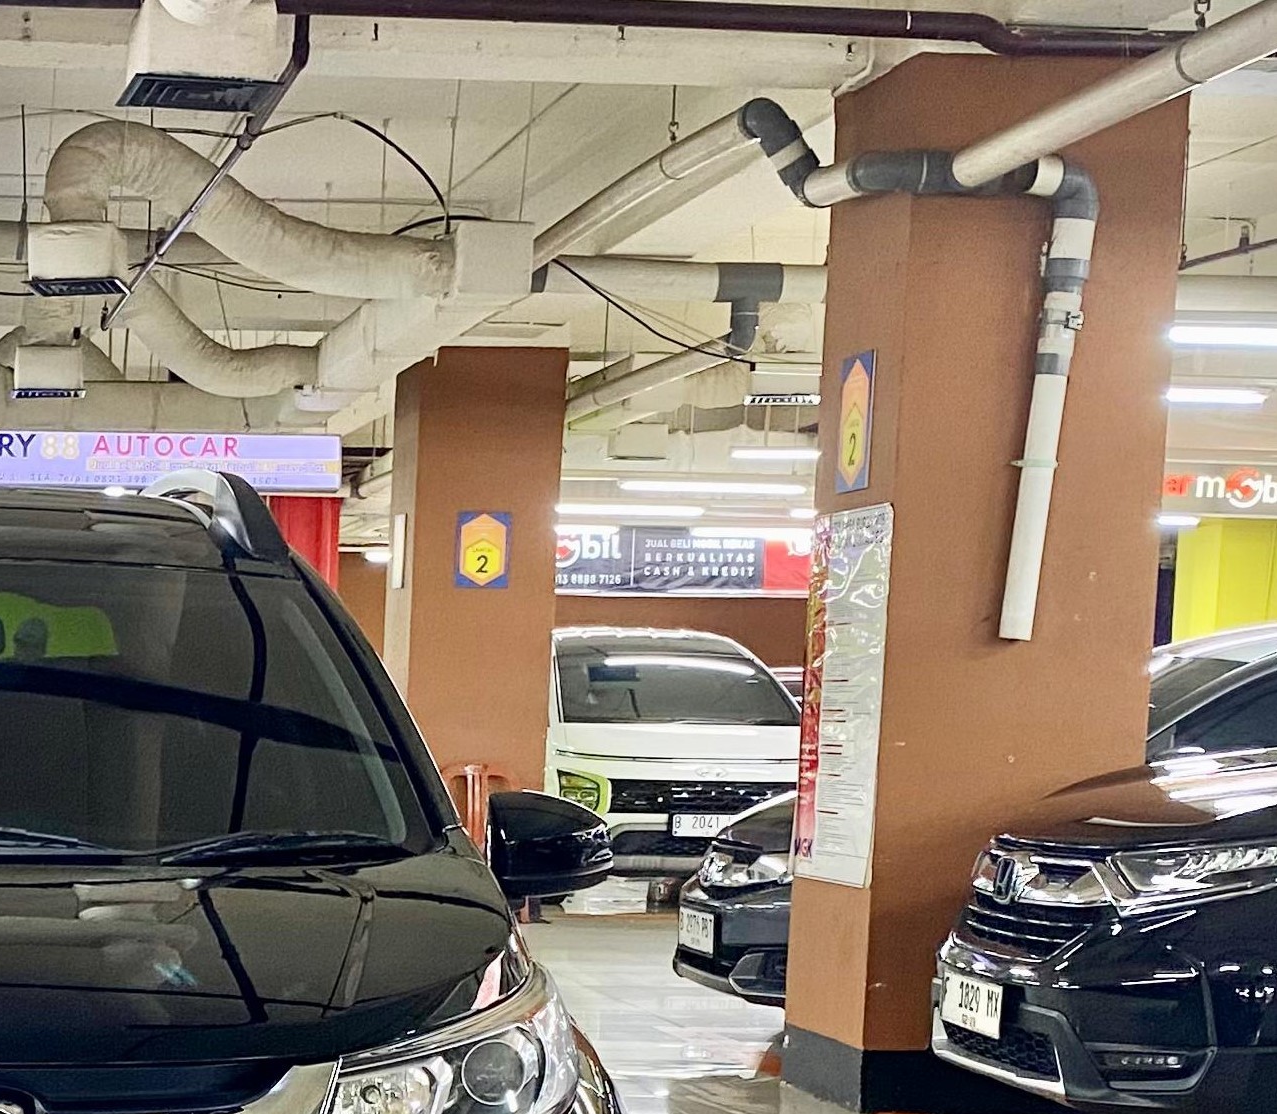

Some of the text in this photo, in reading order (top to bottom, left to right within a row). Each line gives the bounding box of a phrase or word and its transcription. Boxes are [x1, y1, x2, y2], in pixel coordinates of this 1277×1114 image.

[43, 433, 79, 460] 88
[93, 435, 239, 458] AUTOCAR
[848, 432, 856, 466] 2
[644, 539, 669, 549] JUAL
[475, 554, 488, 573] 2
[644, 552, 756, 563] BERKUALITAS
[599, 573, 622, 585] 7126
[644, 566, 681, 577] CASH
[702, 566, 756, 578] KREDIT
[674, 815, 682, 829] B
[692, 816, 720, 830] 2041
[958, 981, 980, 1013] 1829
